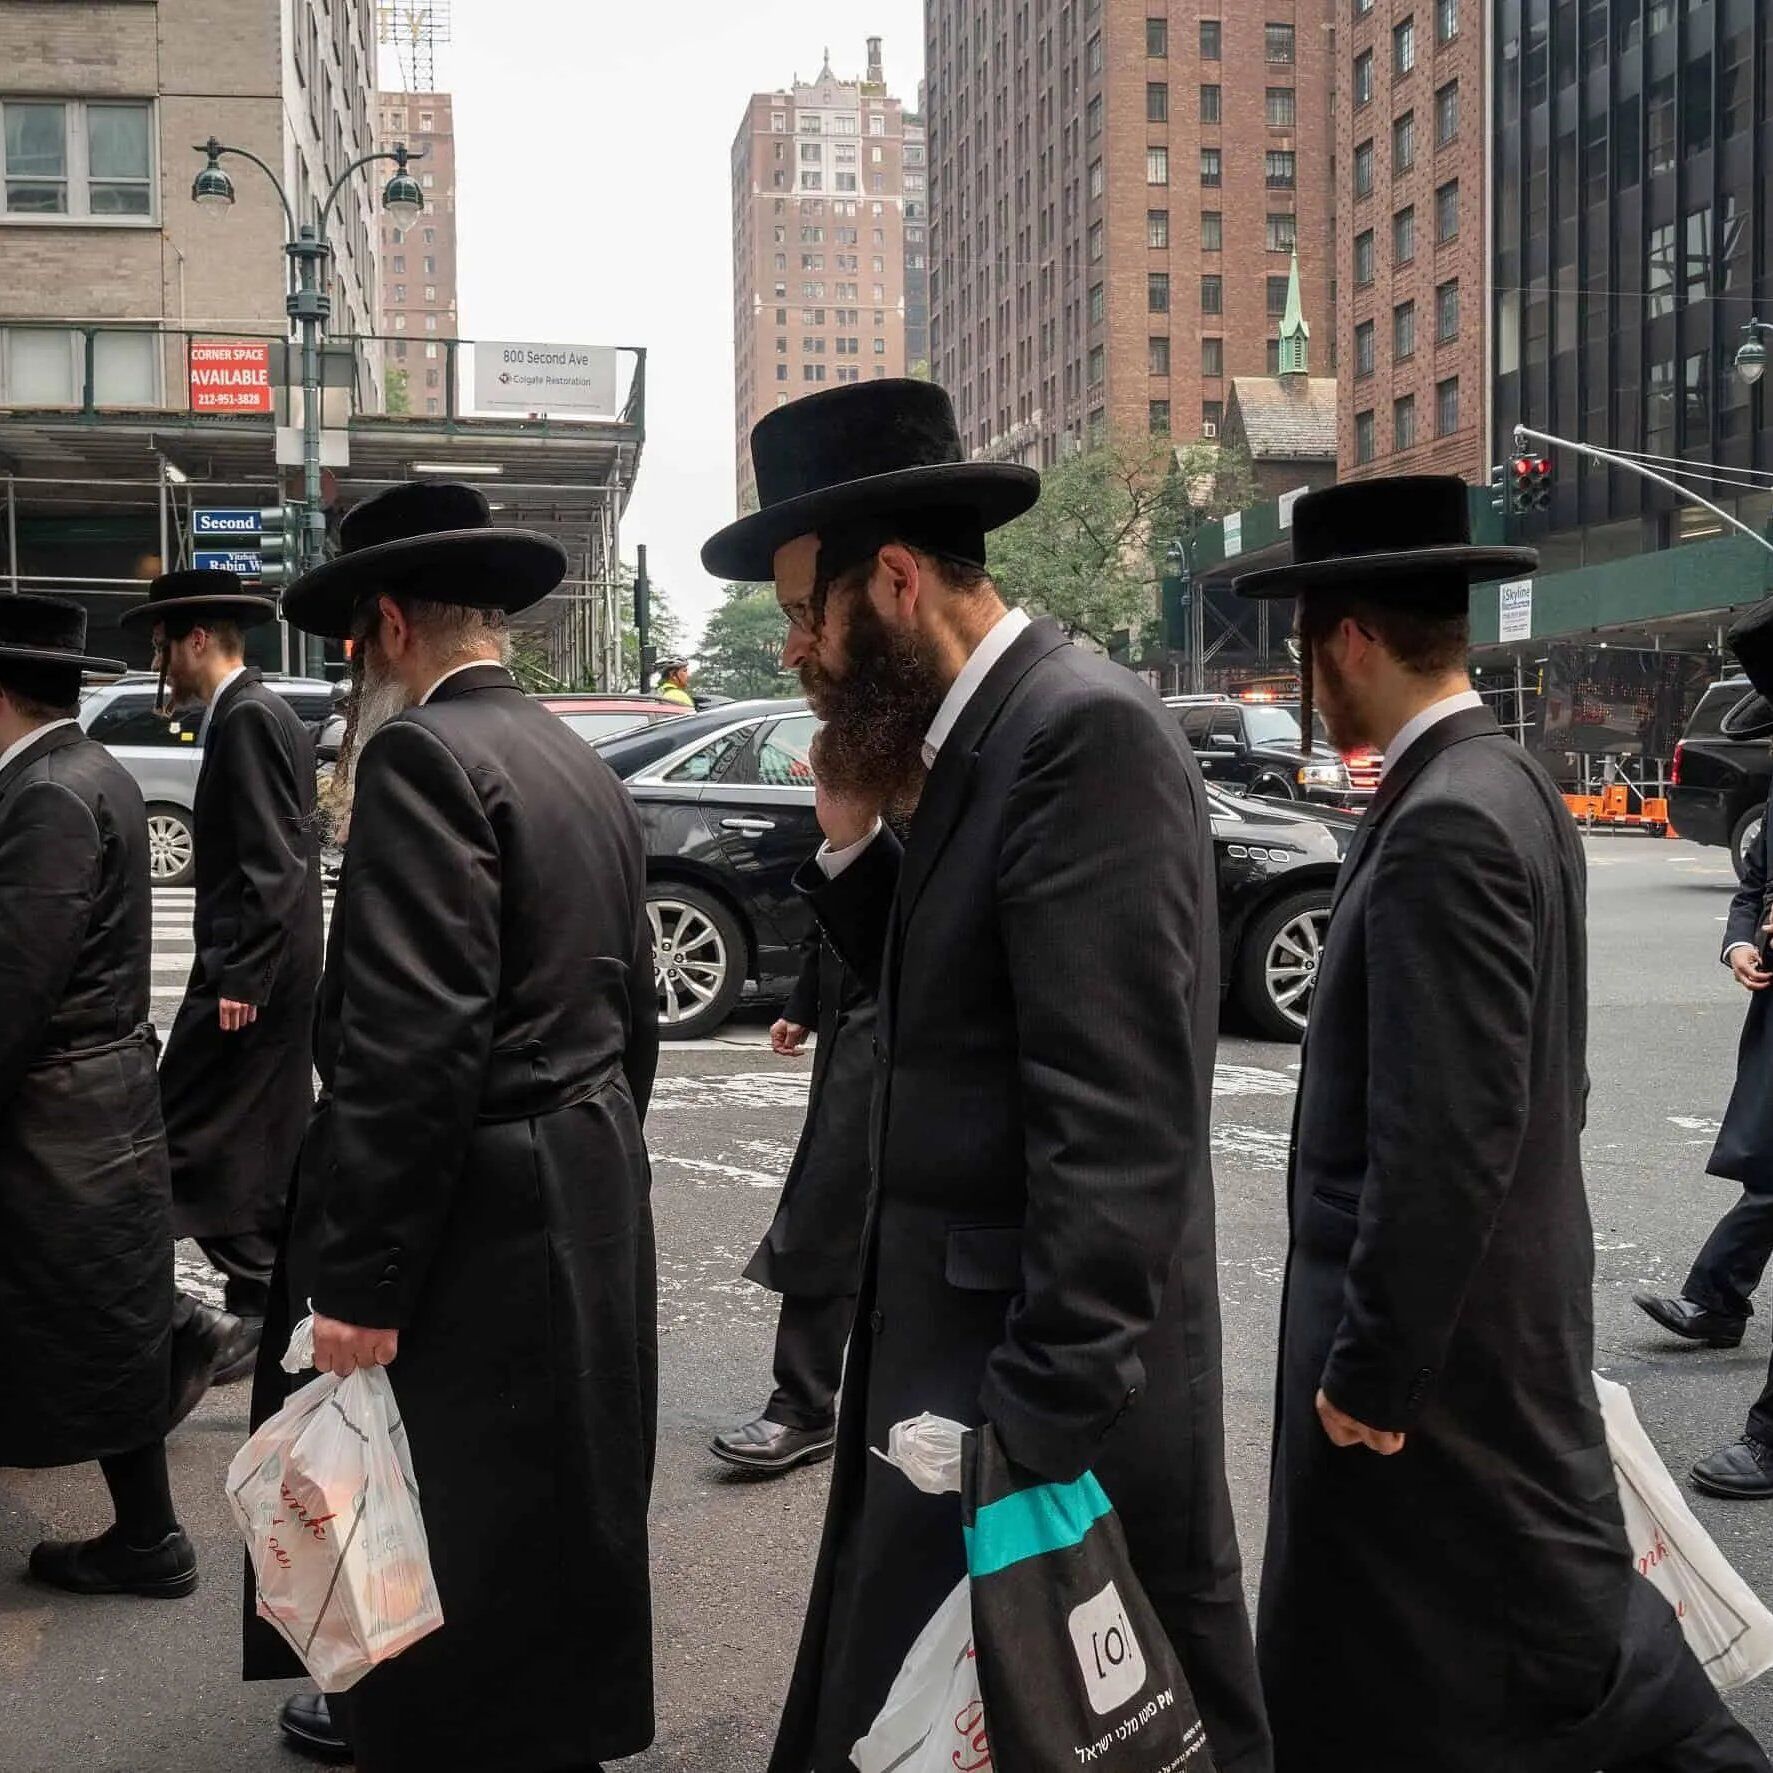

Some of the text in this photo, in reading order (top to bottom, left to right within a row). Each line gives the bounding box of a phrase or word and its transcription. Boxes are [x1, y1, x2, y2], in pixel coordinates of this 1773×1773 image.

[191, 350, 263, 361] CORNER SPACE
[503, 350, 589, 366] 800 Second Ave
[191, 369, 269, 386] AVAILABLE
[545, 375, 591, 387] Restoration
[200, 515, 255, 530] Second
[209, 560, 246, 572] Rabin
[1074, 1733, 1113, 1764] ישראל
